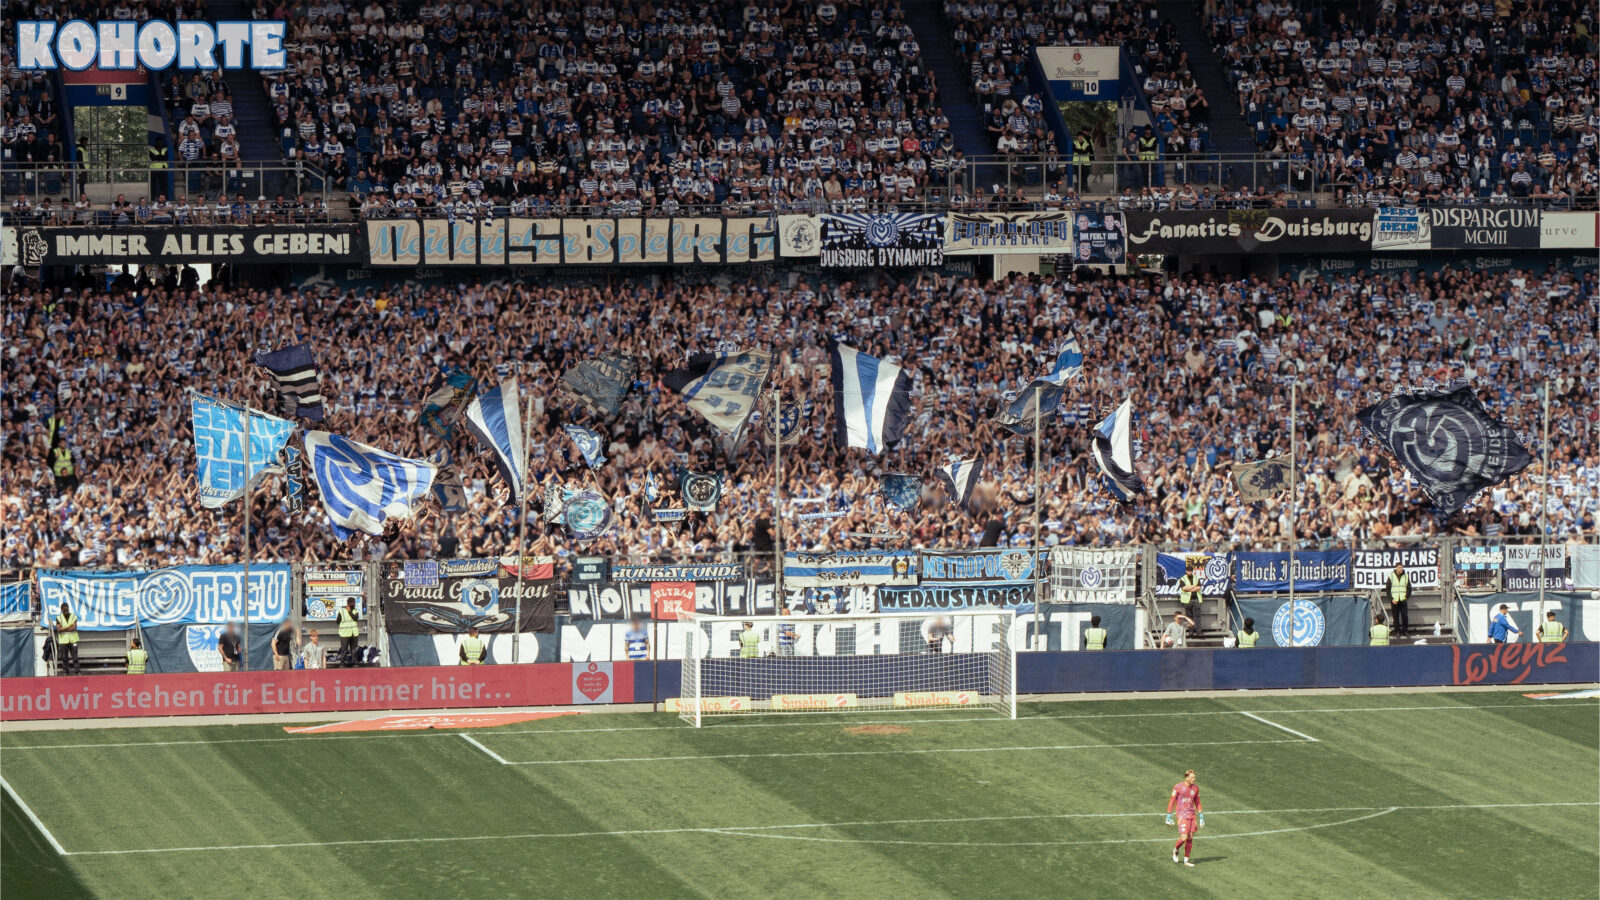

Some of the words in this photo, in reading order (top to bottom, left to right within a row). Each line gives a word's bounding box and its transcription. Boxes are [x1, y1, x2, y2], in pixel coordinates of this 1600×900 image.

[115, 87, 122, 97] 9
[1085, 82, 1097, 92] 10
[1431, 207, 1539, 228] DISPARGUM
[1129, 218, 1241, 244] Fanatics
[1254, 217, 1372, 242] Duisburg
[1380, 222, 1418, 232] HEIM
[1541, 227, 1578, 236] urve
[56, 234, 151, 256] IMMER
[161, 234, 245, 255] ALLES
[253, 233, 350, 255] GEBEN!
[971, 235, 1050, 247] DUISBURG
[1464, 229, 1508, 245] MCMII
[820, 249, 875, 267] DUISBURG
[879, 248, 944, 267] DYNAMITES
[1054, 550, 1133, 565] RUHRPOTT
[1356, 550, 1437, 567] ZEBRAFANS
[1508, 547, 1562, 559] MSV-FANS
[440, 560, 497, 575] Freundeskreis
[1241, 560, 1275, 581] Block
[1294, 558, 1347, 583] Duisburg
[817, 570, 861, 581] CREW
[1508, 577, 1562, 589] HOCHFELD
[388, 580, 445, 600] Proud
[653, 587, 694, 600] ULTRAS
[879, 585, 1036, 609] WEDAUSTADION
[1056, 588, 1127, 603] KANAKEN
[40, 577, 138, 627] EWIG
[190, 571, 287, 623] TREU
[0, 688, 51, 712] und
[60, 687, 104, 711] wir
[111, 684, 205, 709] stehen
[212, 683, 253, 706] für
[261, 681, 325, 704] Euch
[335, 680, 424, 703] immer
[431, 677, 512, 700] hier...
[781, 695, 828, 709] Sinalco
[904, 692, 950, 706] Sinalco
